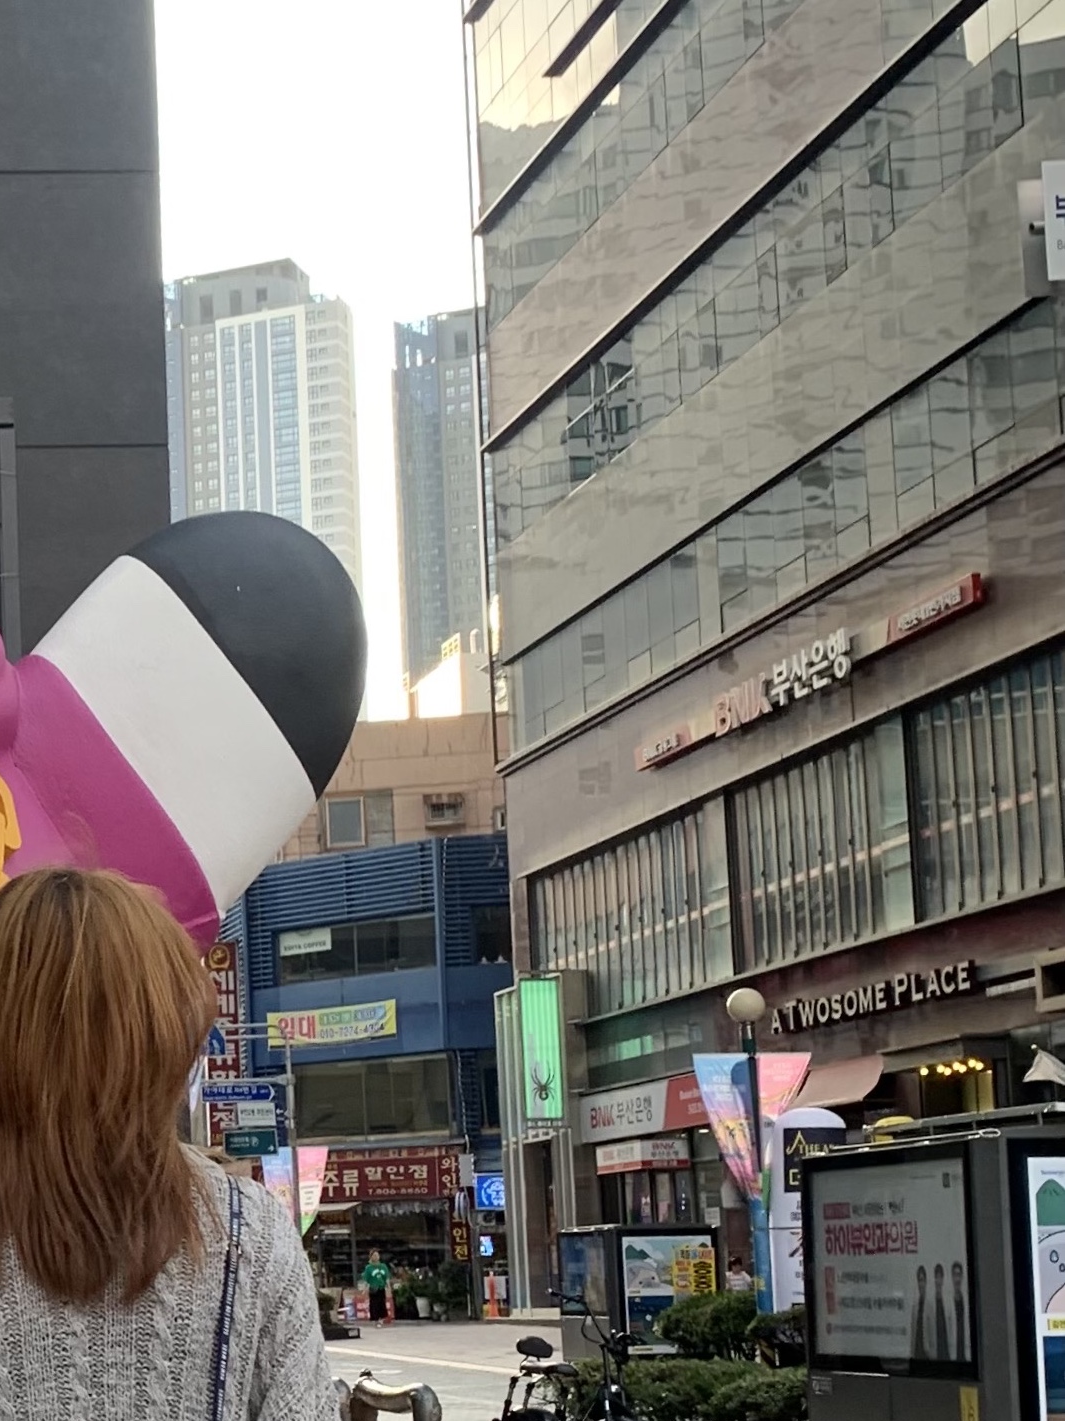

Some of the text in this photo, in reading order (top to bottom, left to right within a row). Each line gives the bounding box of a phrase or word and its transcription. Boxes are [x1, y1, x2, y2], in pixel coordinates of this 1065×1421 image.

[715, 627, 851, 737] BNK 부산은행
[770, 1009, 782, 1034] A
[784, 982, 887, 1031] TWOSOME
[893, 960, 972, 1006] PLACE
[278, 1013, 316, 1041] 임대
[590, 1096, 653, 1129] BNK 부산은행
[323, 1169, 360, 1197] 주류
[364, 1164, 428, 1181] 할인점
[440, 1156, 458, 1189] 와인
